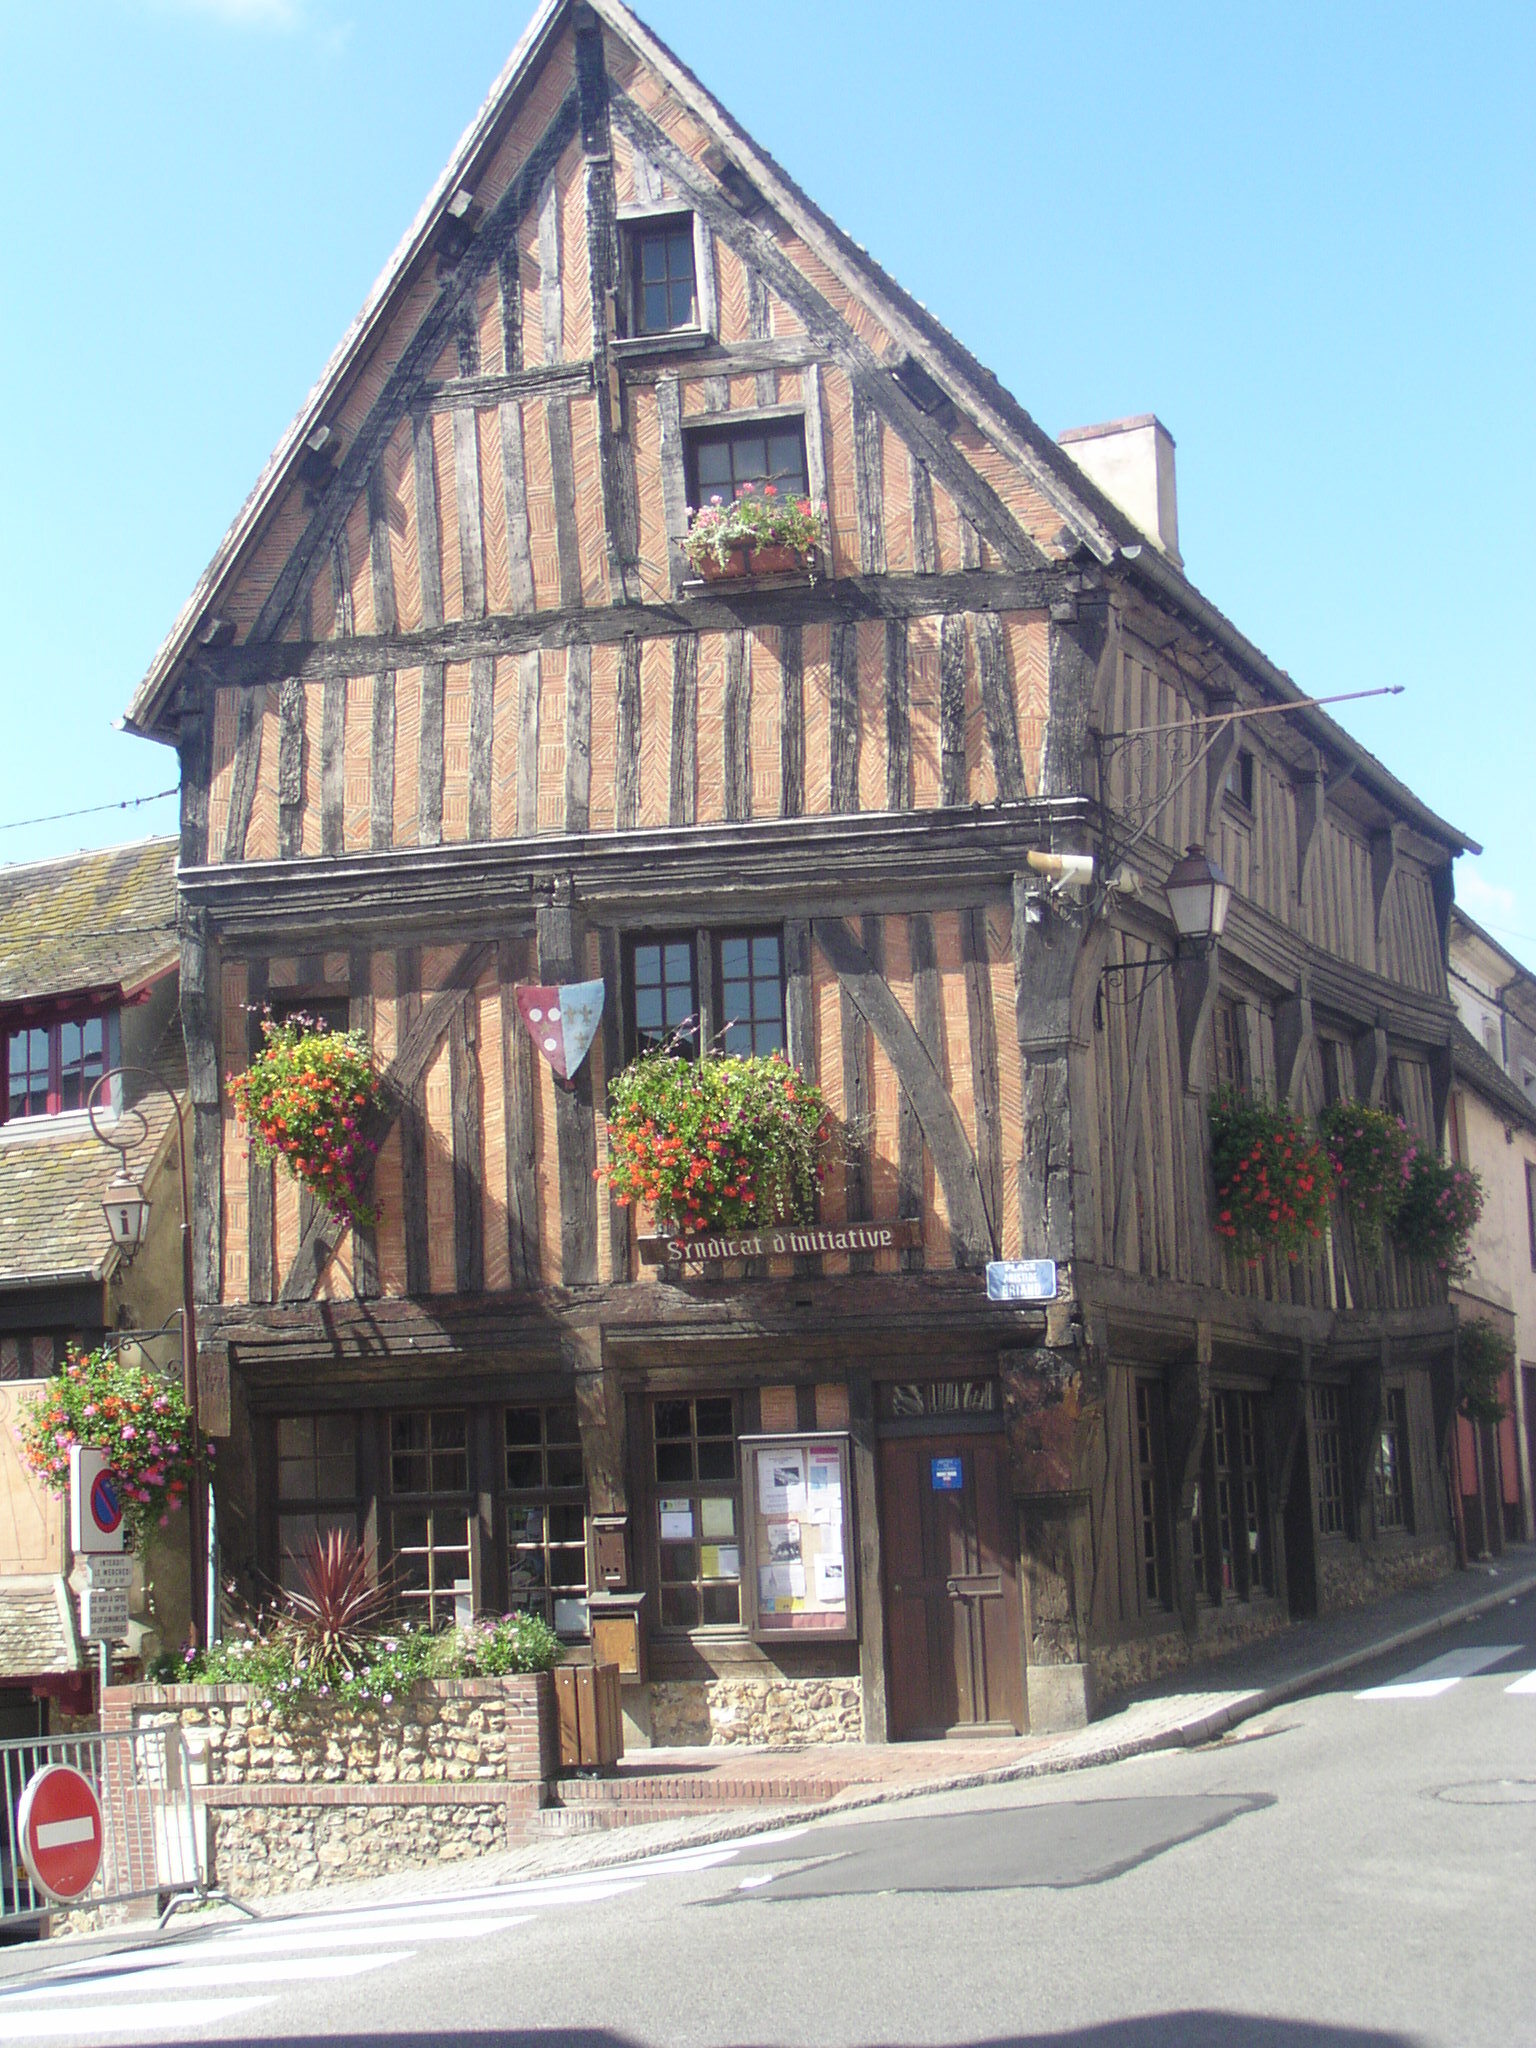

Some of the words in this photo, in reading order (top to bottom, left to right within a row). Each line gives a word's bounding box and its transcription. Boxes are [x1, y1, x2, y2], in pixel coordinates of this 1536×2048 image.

[667, 1236, 763, 1260] Syndicat
[773, 1229, 893, 1253] d'initiative
[1004, 1263, 1036, 1272] PLACE
[1001, 1283, 1042, 1297] BRIAND
